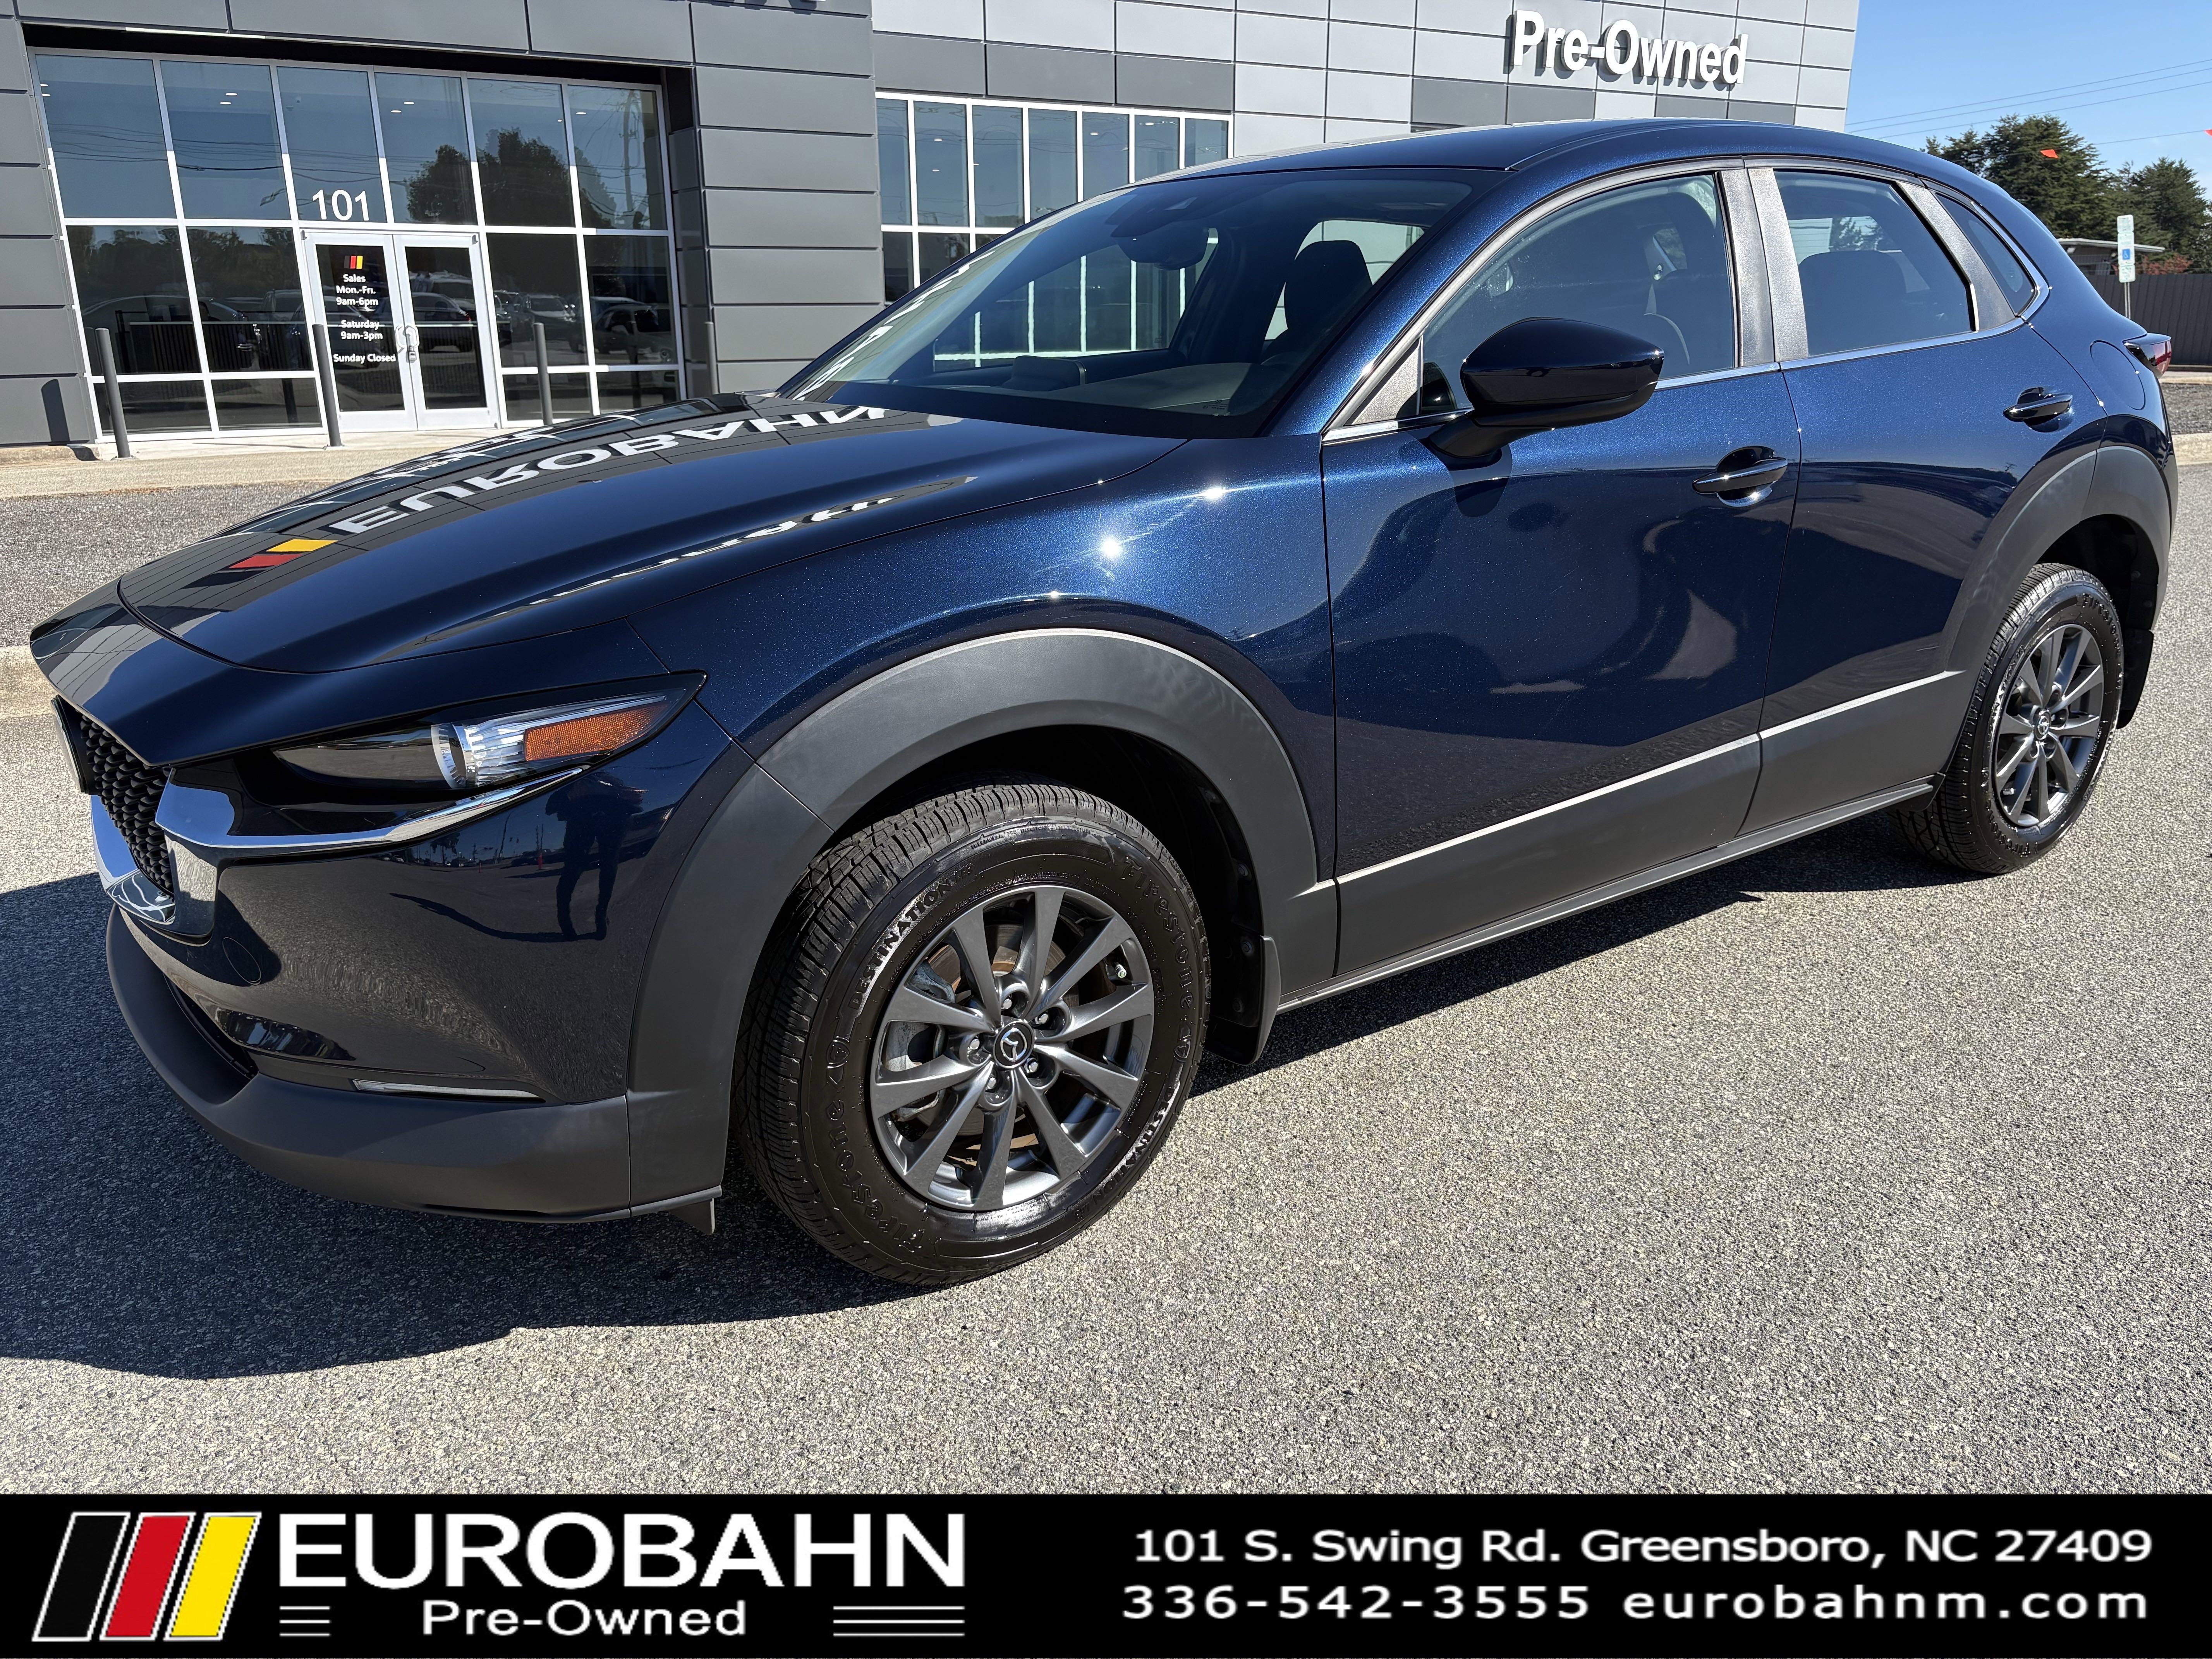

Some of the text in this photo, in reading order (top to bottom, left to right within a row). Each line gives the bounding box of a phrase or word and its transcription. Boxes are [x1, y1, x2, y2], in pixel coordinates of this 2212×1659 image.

[1513, 9, 1748, 84] Pre-Owned
[312, 189, 369, 221] 101
[343, 273, 366, 283] Sales
[336, 297, 379, 308] 9am-6pm
[341, 319, 380, 330] Saturday
[340, 331, 383, 342] 9am-3pm
[333, 353, 396, 364] Sunday Closed
[1121, 857, 1194, 1009] Firestone
[848, 876, 957, 1010] DESTINATION
